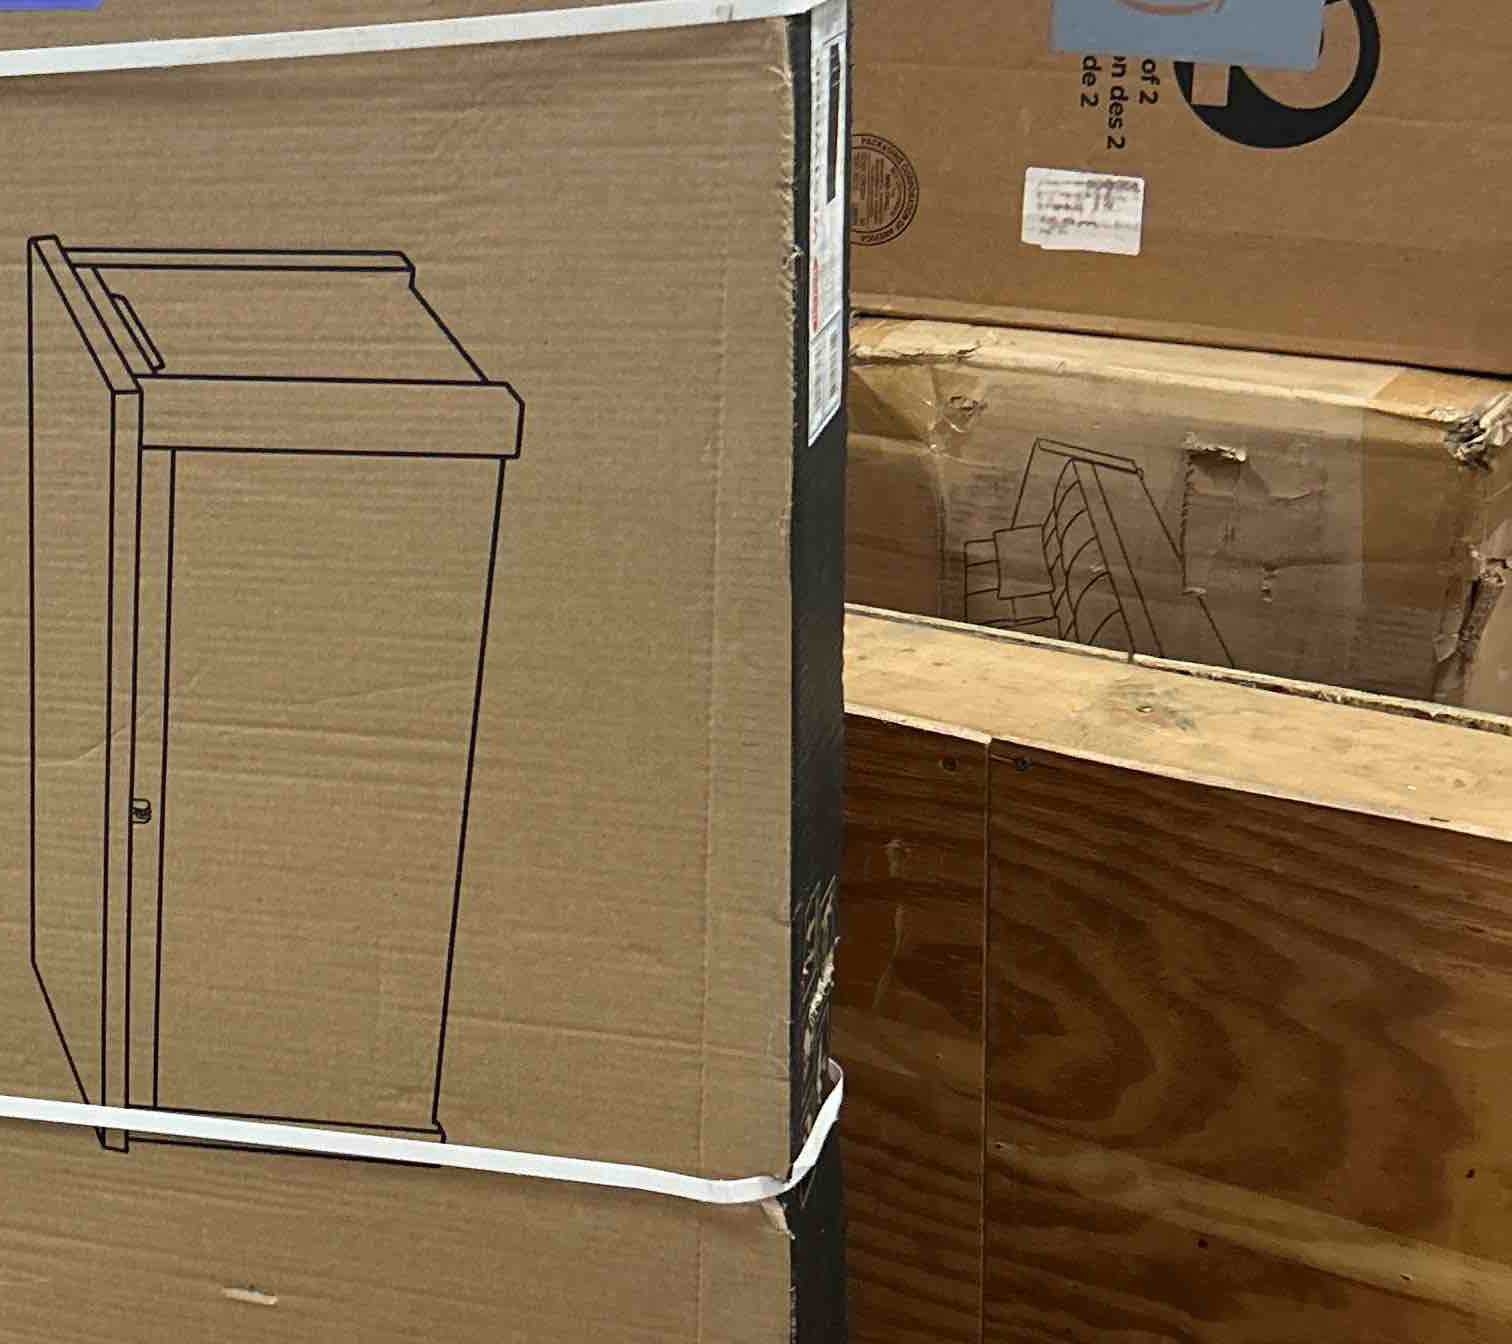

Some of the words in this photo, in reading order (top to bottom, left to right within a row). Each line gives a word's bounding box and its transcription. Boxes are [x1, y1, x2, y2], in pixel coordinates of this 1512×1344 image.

[1081, 56, 1103, 87] de
[1139, 59, 1161, 85] of
[1080, 93, 1099, 108] 2
[1108, 85, 1129, 130] des
[1139, 90, 1159, 105] 2
[1106, 135, 1126, 150] 2
